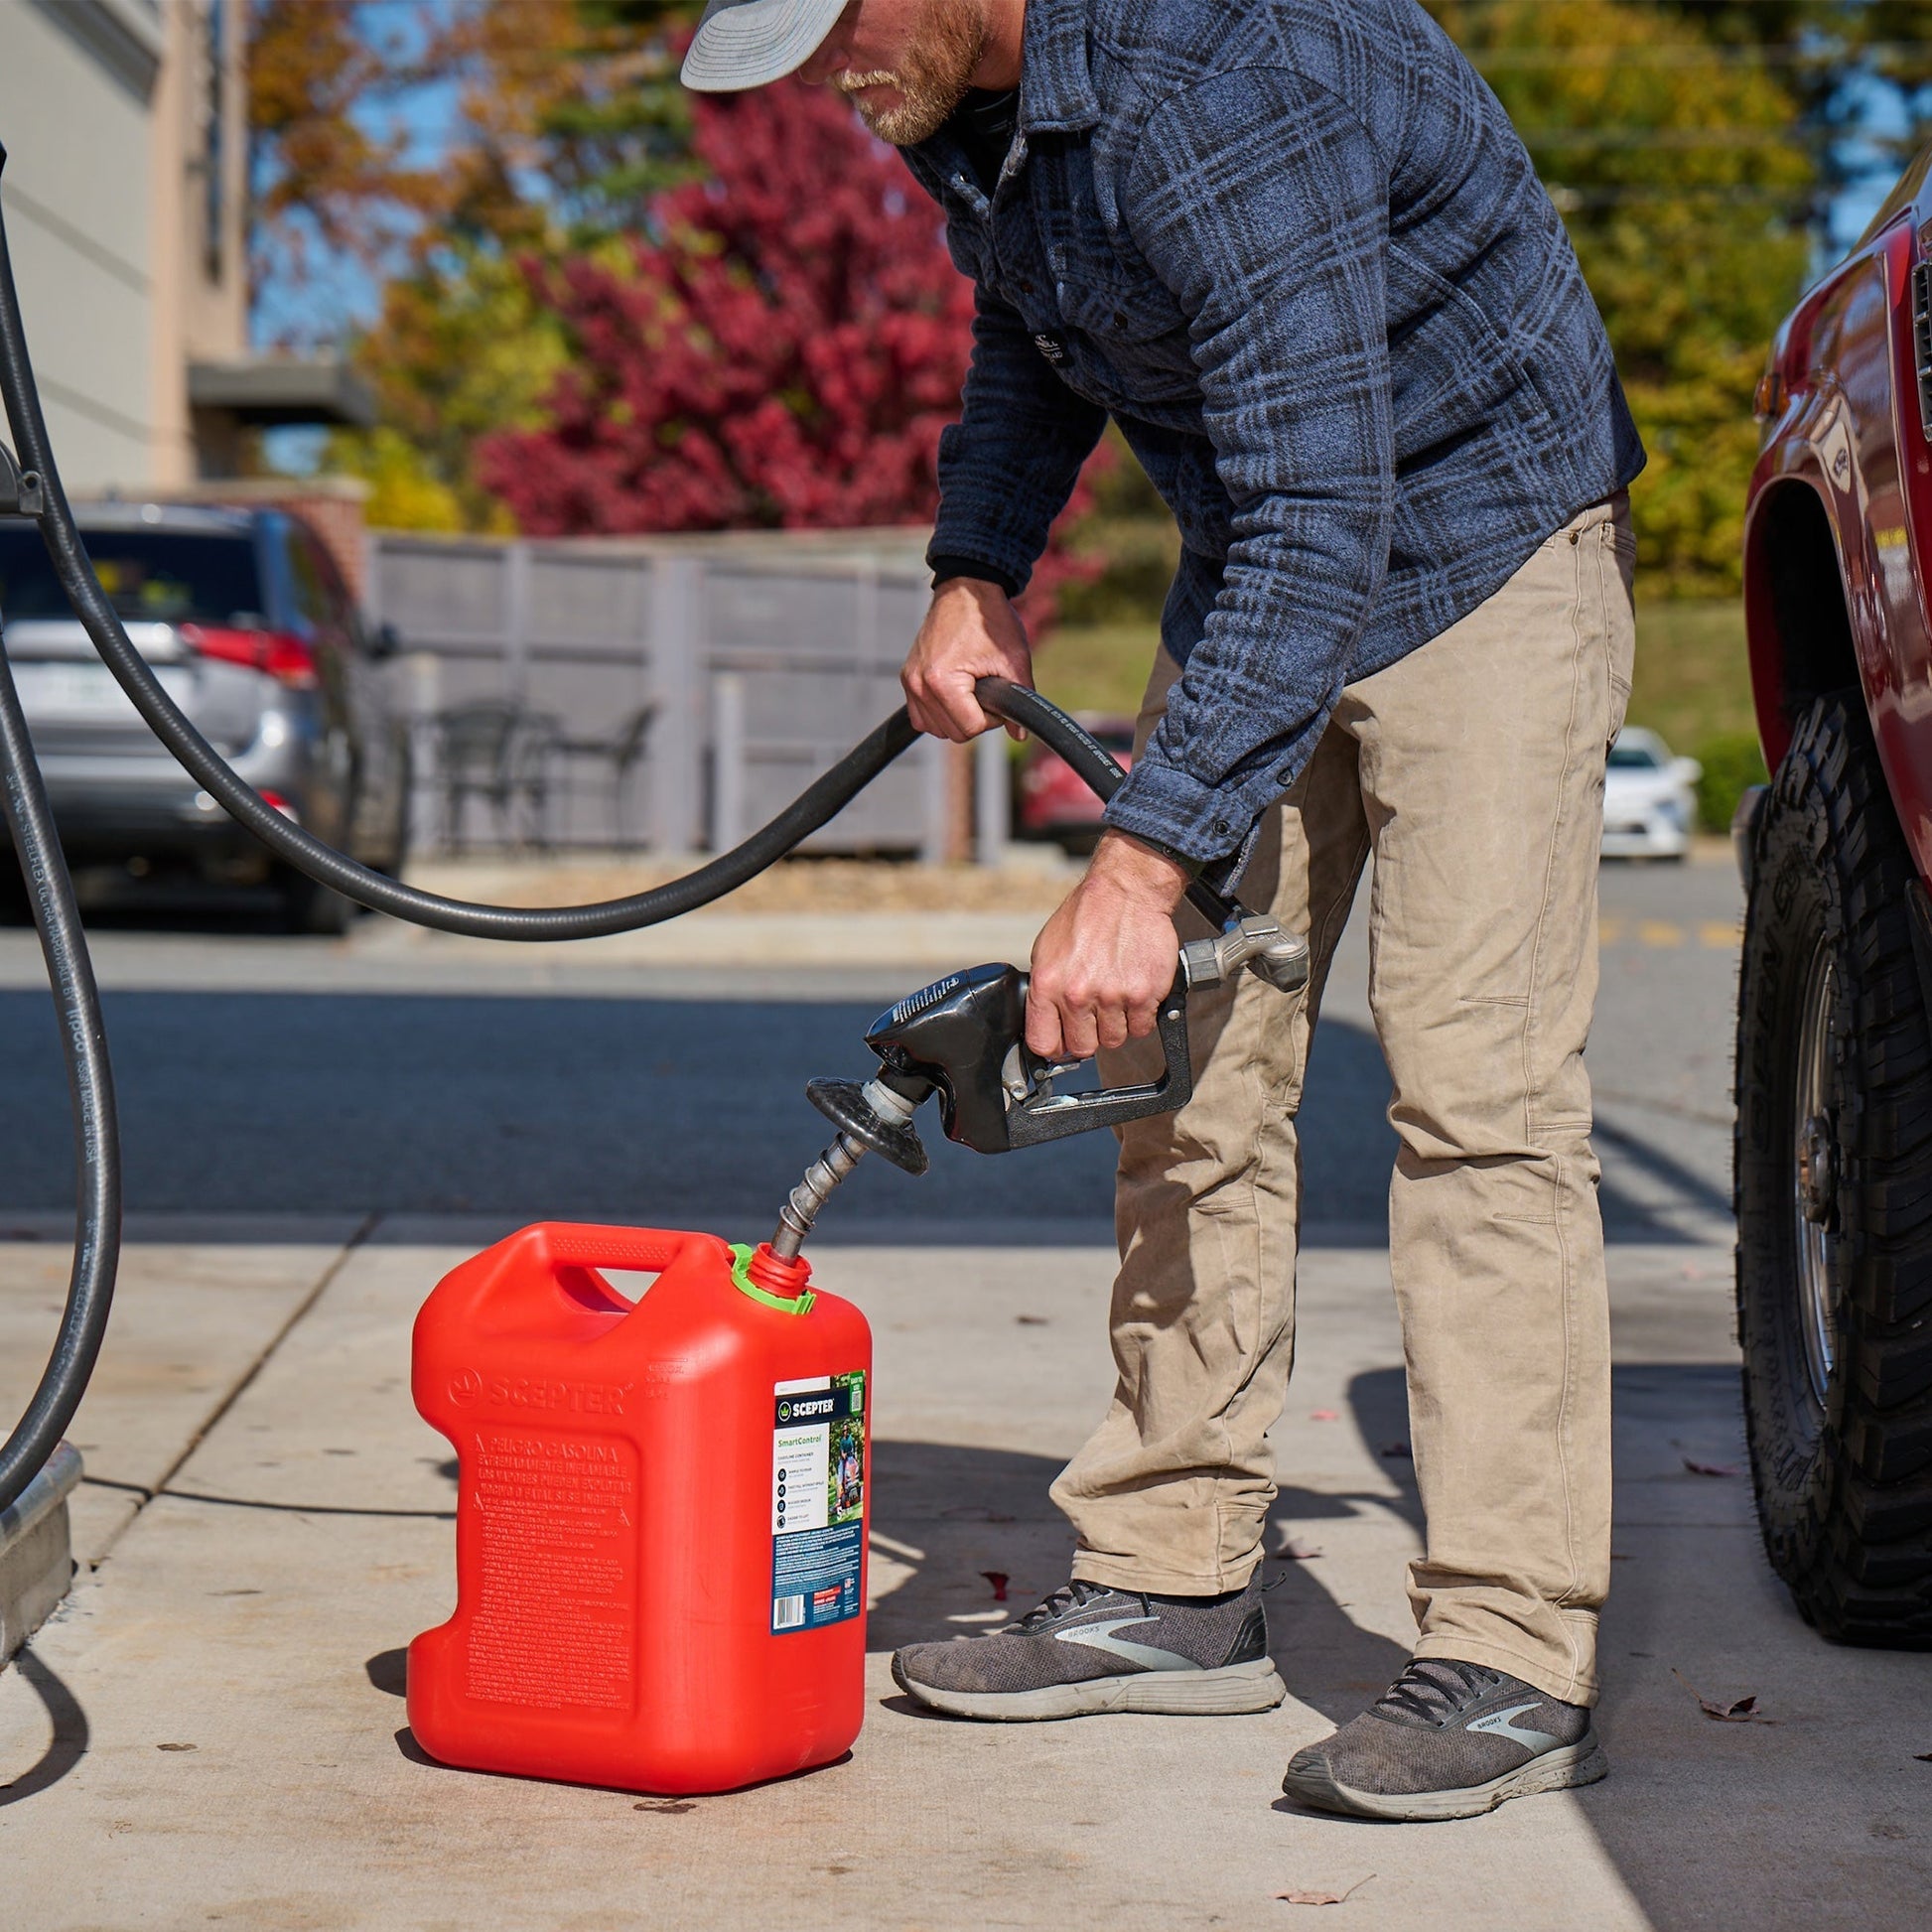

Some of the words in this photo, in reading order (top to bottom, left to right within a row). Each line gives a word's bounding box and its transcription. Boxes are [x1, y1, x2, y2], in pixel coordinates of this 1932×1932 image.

[22, 823, 46, 885] STEELFLEX
[38, 887, 57, 923] ULTRA
[48, 922, 74, 985] HARDWALL
[79, 1083, 96, 1121] MADE
[85, 1140, 99, 1165] USA
[490, 1377, 624, 1415] SCEPTER
[792, 1399, 834, 1418] SCEPTER
[490, 1437, 543, 1457] PELIGRO
[546, 1443, 618, 1462] GASOLINA
[777, 1435, 822, 1448] SmartControl
[1068, 1625, 1100, 1638] BROOKS
[1477, 1717, 1501, 1729] BROOKS
